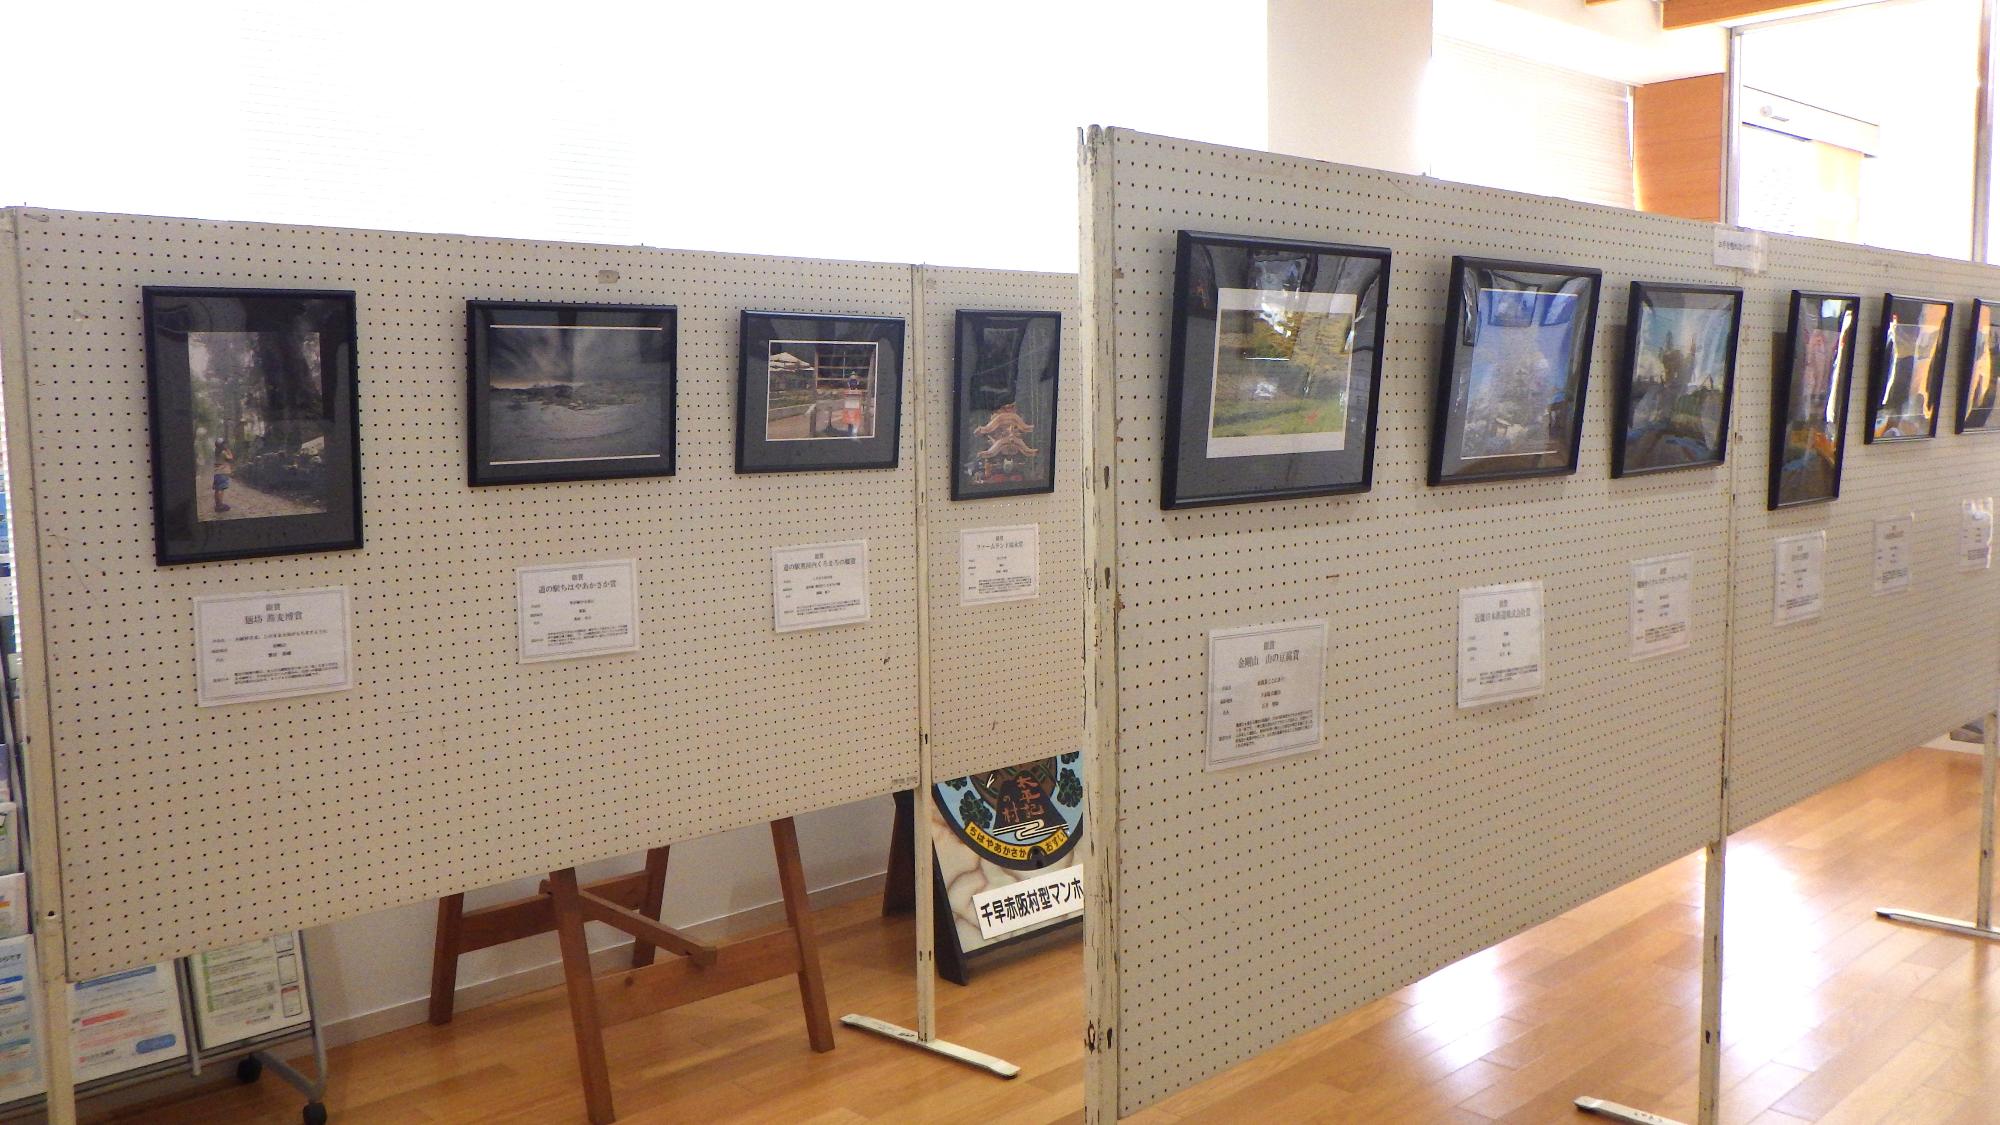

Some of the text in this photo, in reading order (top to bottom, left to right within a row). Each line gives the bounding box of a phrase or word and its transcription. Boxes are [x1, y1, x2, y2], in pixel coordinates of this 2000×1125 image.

[969, 826, 1027, 857] ちはやあかさか
